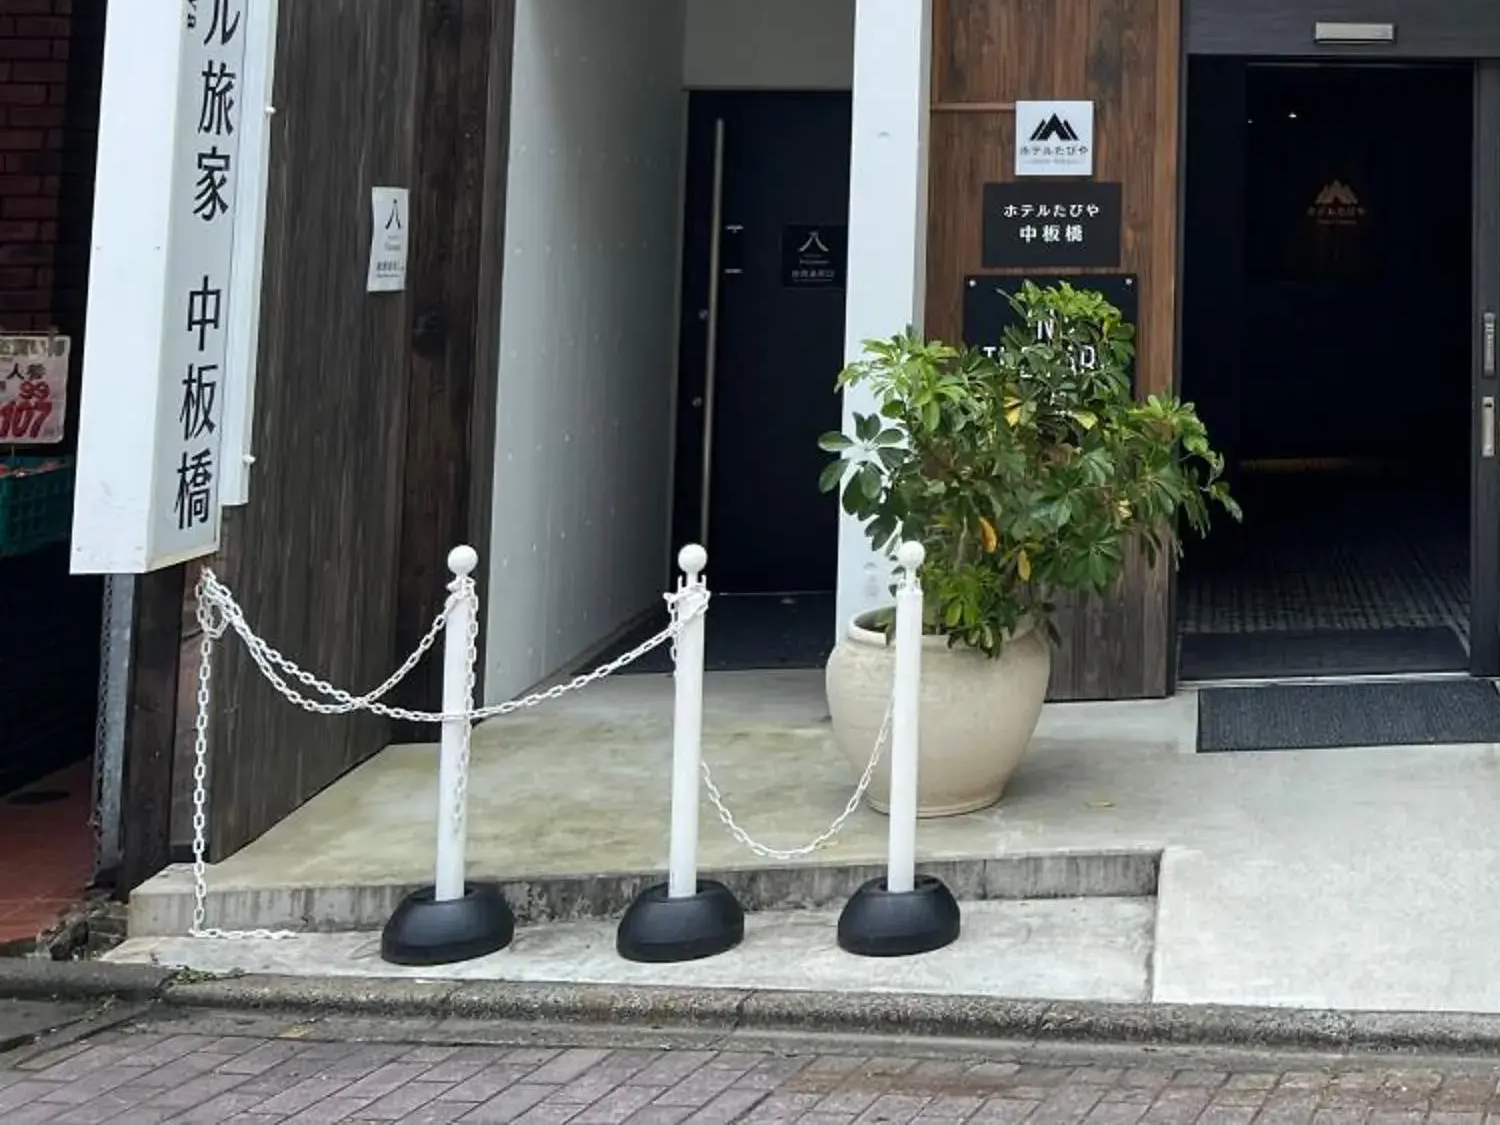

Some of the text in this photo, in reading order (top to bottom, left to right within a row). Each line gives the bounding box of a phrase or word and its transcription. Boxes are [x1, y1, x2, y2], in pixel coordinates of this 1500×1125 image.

[1020, 145, 1089, 157] ホテルたびや
[1003, 204, 1100, 218] ホテルたびや
[1019, 225, 1084, 243] 中板橋
[173, 275, 221, 530] 中板橋
